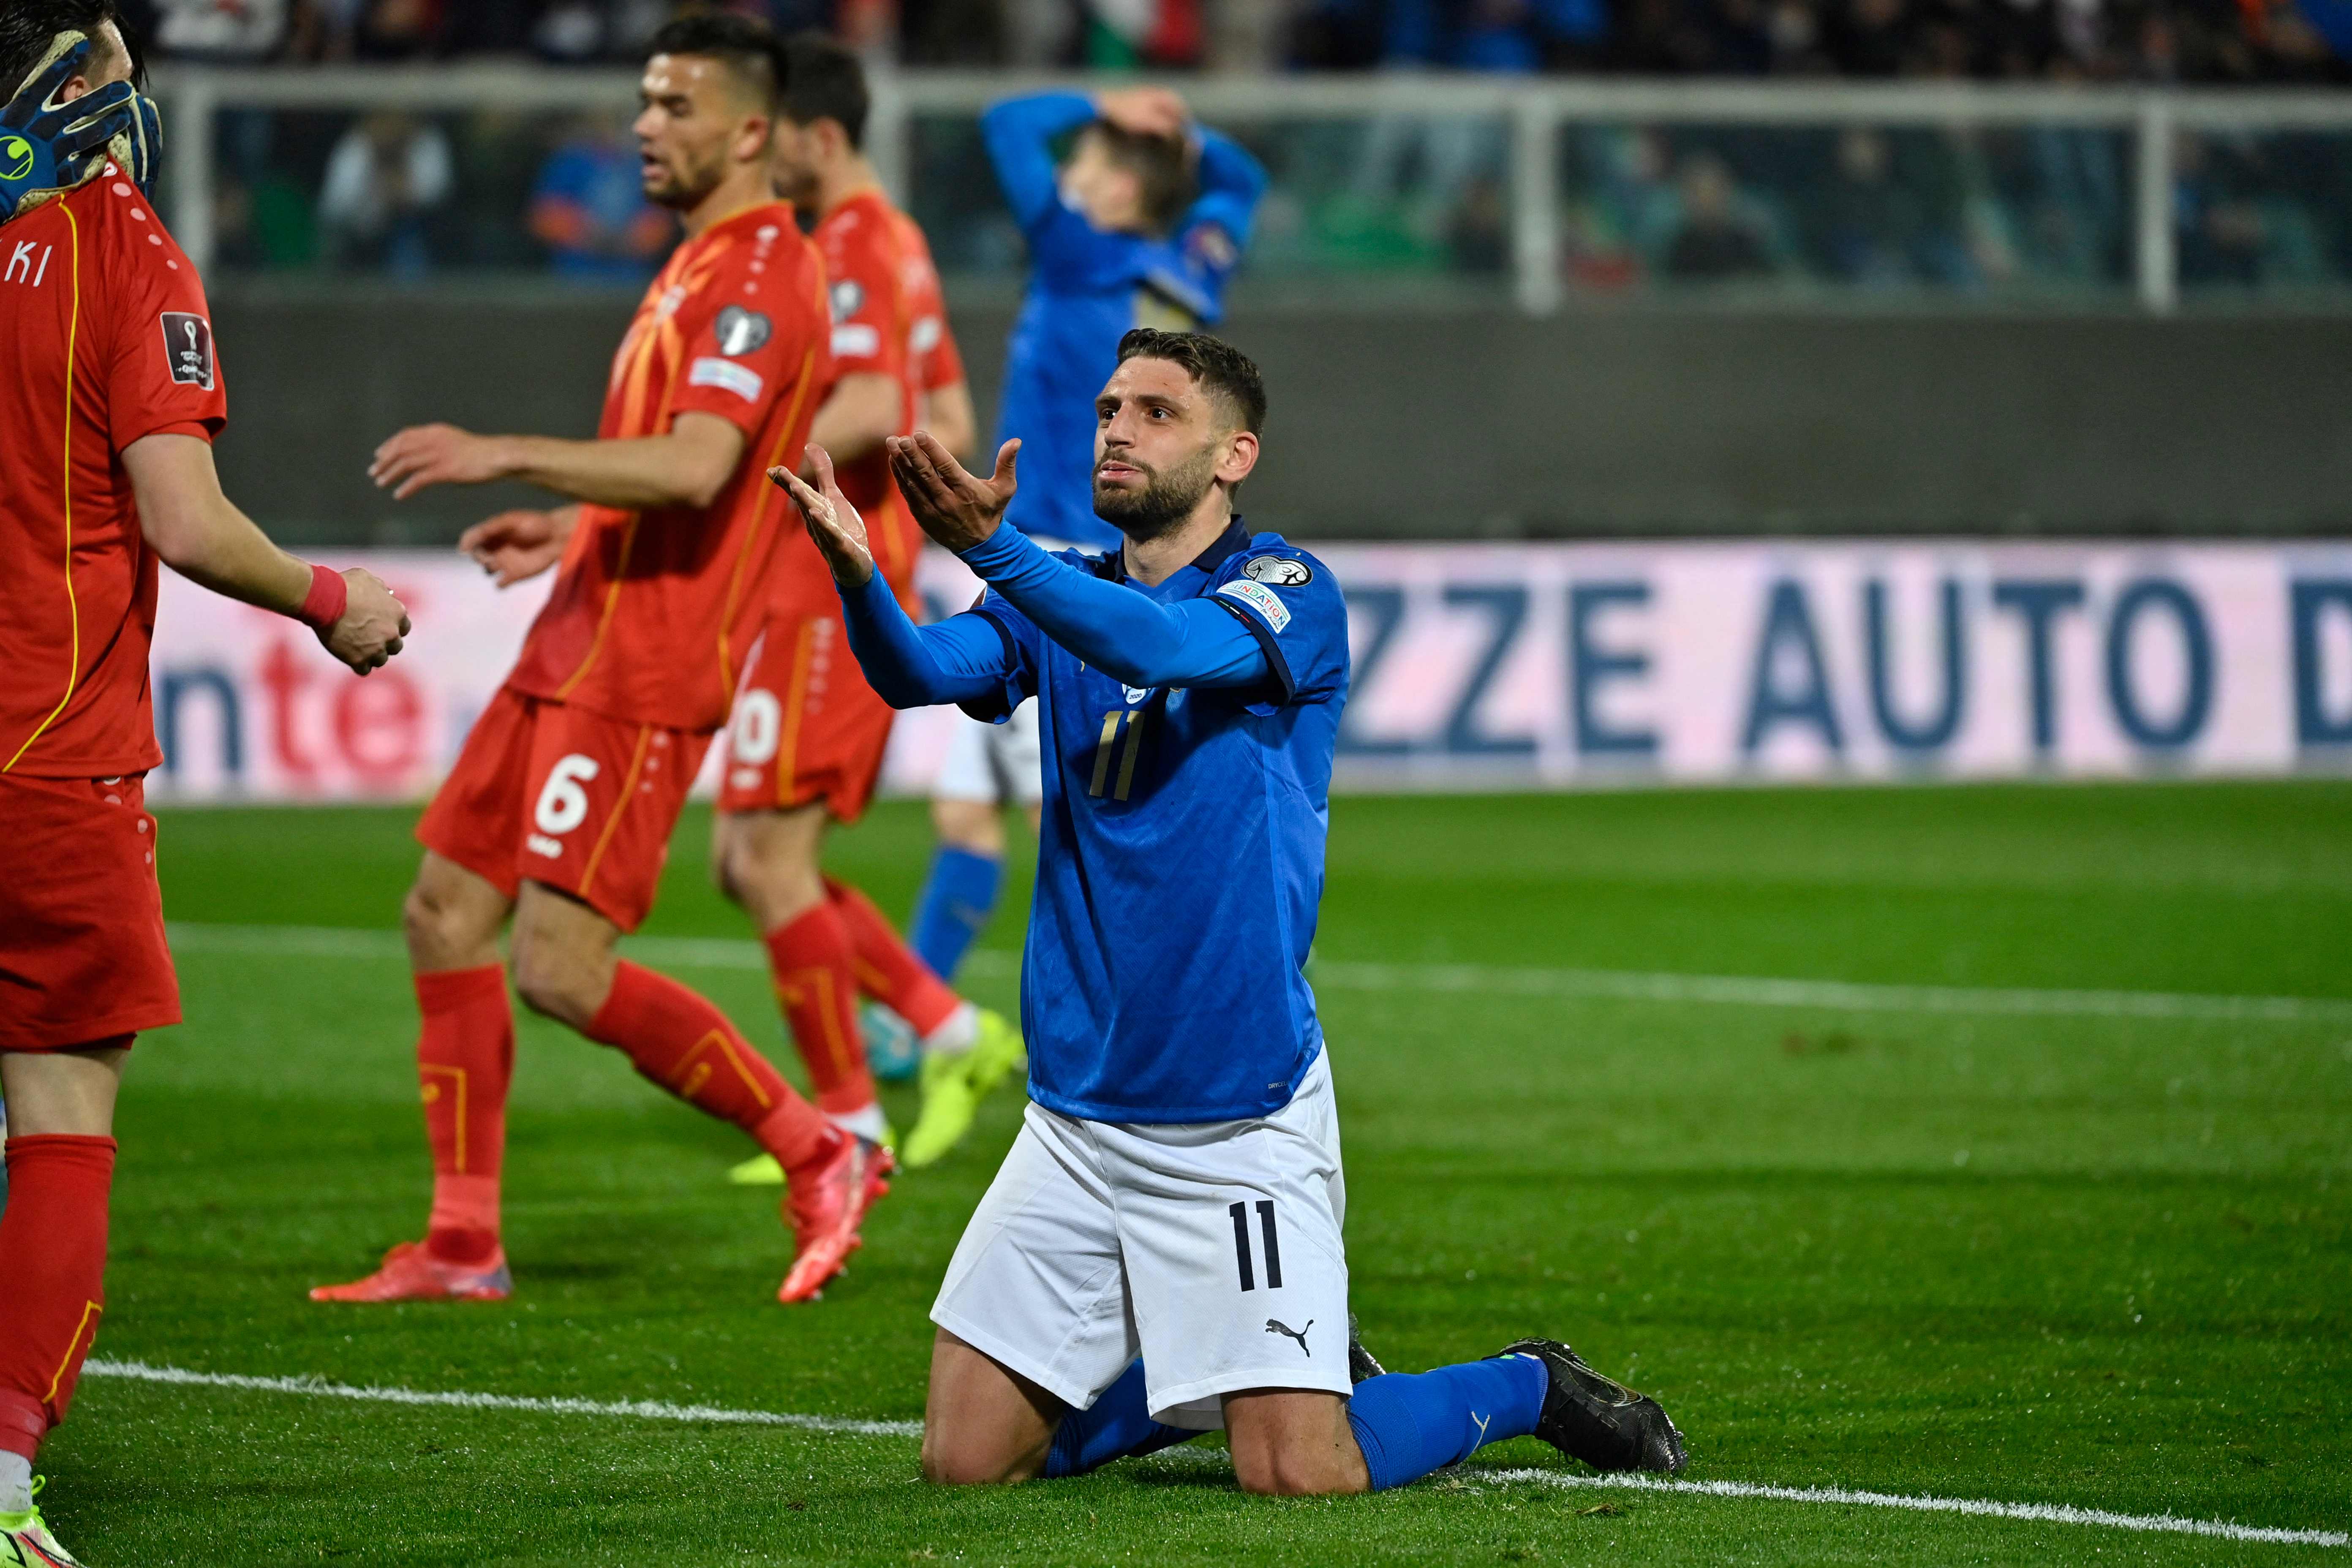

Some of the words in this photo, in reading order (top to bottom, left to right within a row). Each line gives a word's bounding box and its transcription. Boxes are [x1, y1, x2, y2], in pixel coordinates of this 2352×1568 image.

[0, 238, 53, 287] KI
[1223, 583, 1285, 626] OUNDATION
[1740, 578, 2214, 749] AUTO
[534, 753, 599, 834] 6
[1089, 710, 1146, 801] 11
[1229, 1200, 1282, 1292] 11
